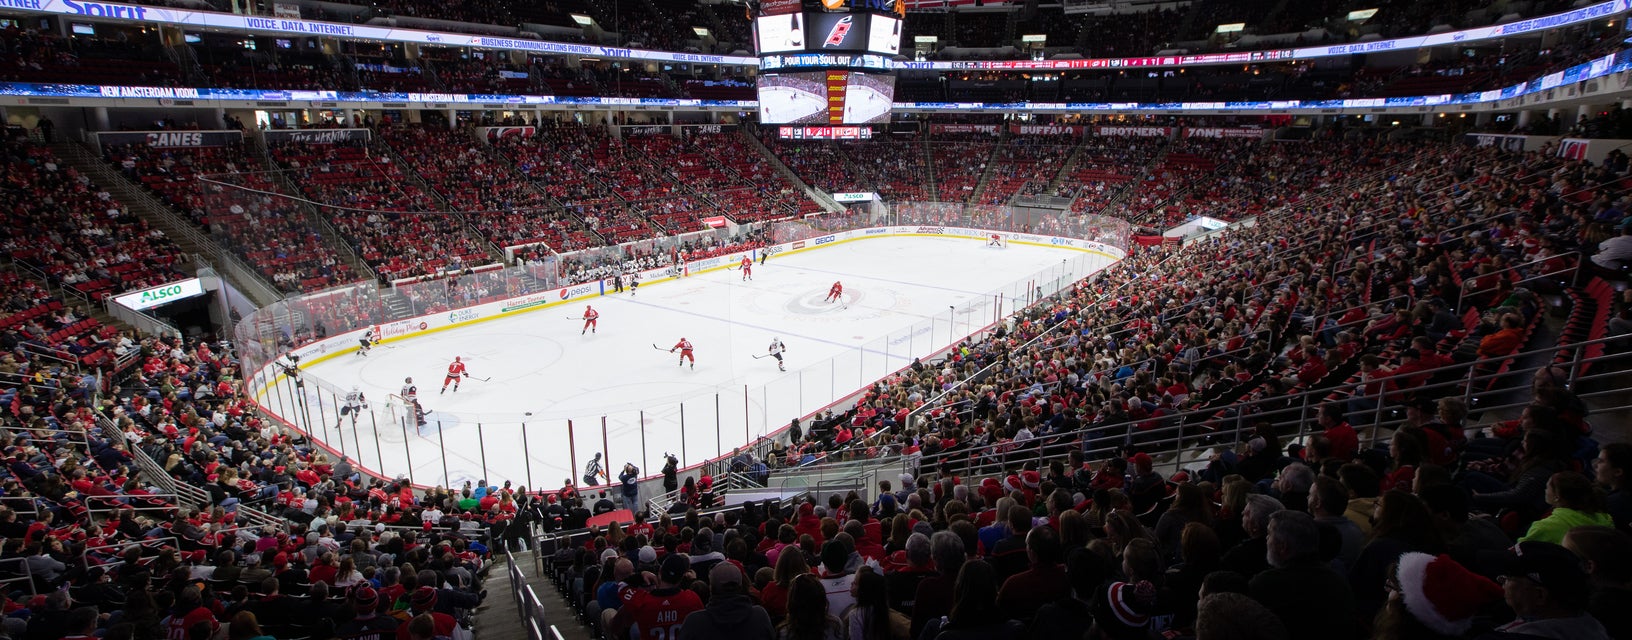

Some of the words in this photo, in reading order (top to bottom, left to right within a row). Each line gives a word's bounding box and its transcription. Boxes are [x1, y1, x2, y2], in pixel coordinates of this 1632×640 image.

[63, 0, 147, 19] Spirit
[247, 18, 279, 30] VOICE.
[282, 22, 307, 32] DATA.
[309, 23, 353, 36] INTERNET.
[482, 38, 513, 48] BUSINESS
[514, 40, 567, 52] COMMUNICATIONS
[568, 44, 592, 54] PARTNER
[802, 57, 819, 65] YOUR
[820, 56, 836, 65] SOUL
[838, 56, 851, 66] OUT
[101, 86, 120, 97] NEW
[122, 86, 174, 98] AMSTERDAM
[175, 88, 199, 98] VODKA
[408, 93, 420, 101] NEW
[1020, 126, 1073, 135] BUFFALO
[1100, 127, 1164, 136] BROTHERS
[1188, 129, 1223, 138] ZONE
[147, 133, 202, 146] CANES
[815, 235, 835, 245] GEICO
[141, 285, 182, 303] ALSCO
[571, 286, 592, 297] pepsi
[657, 610, 678, 622] AHO
